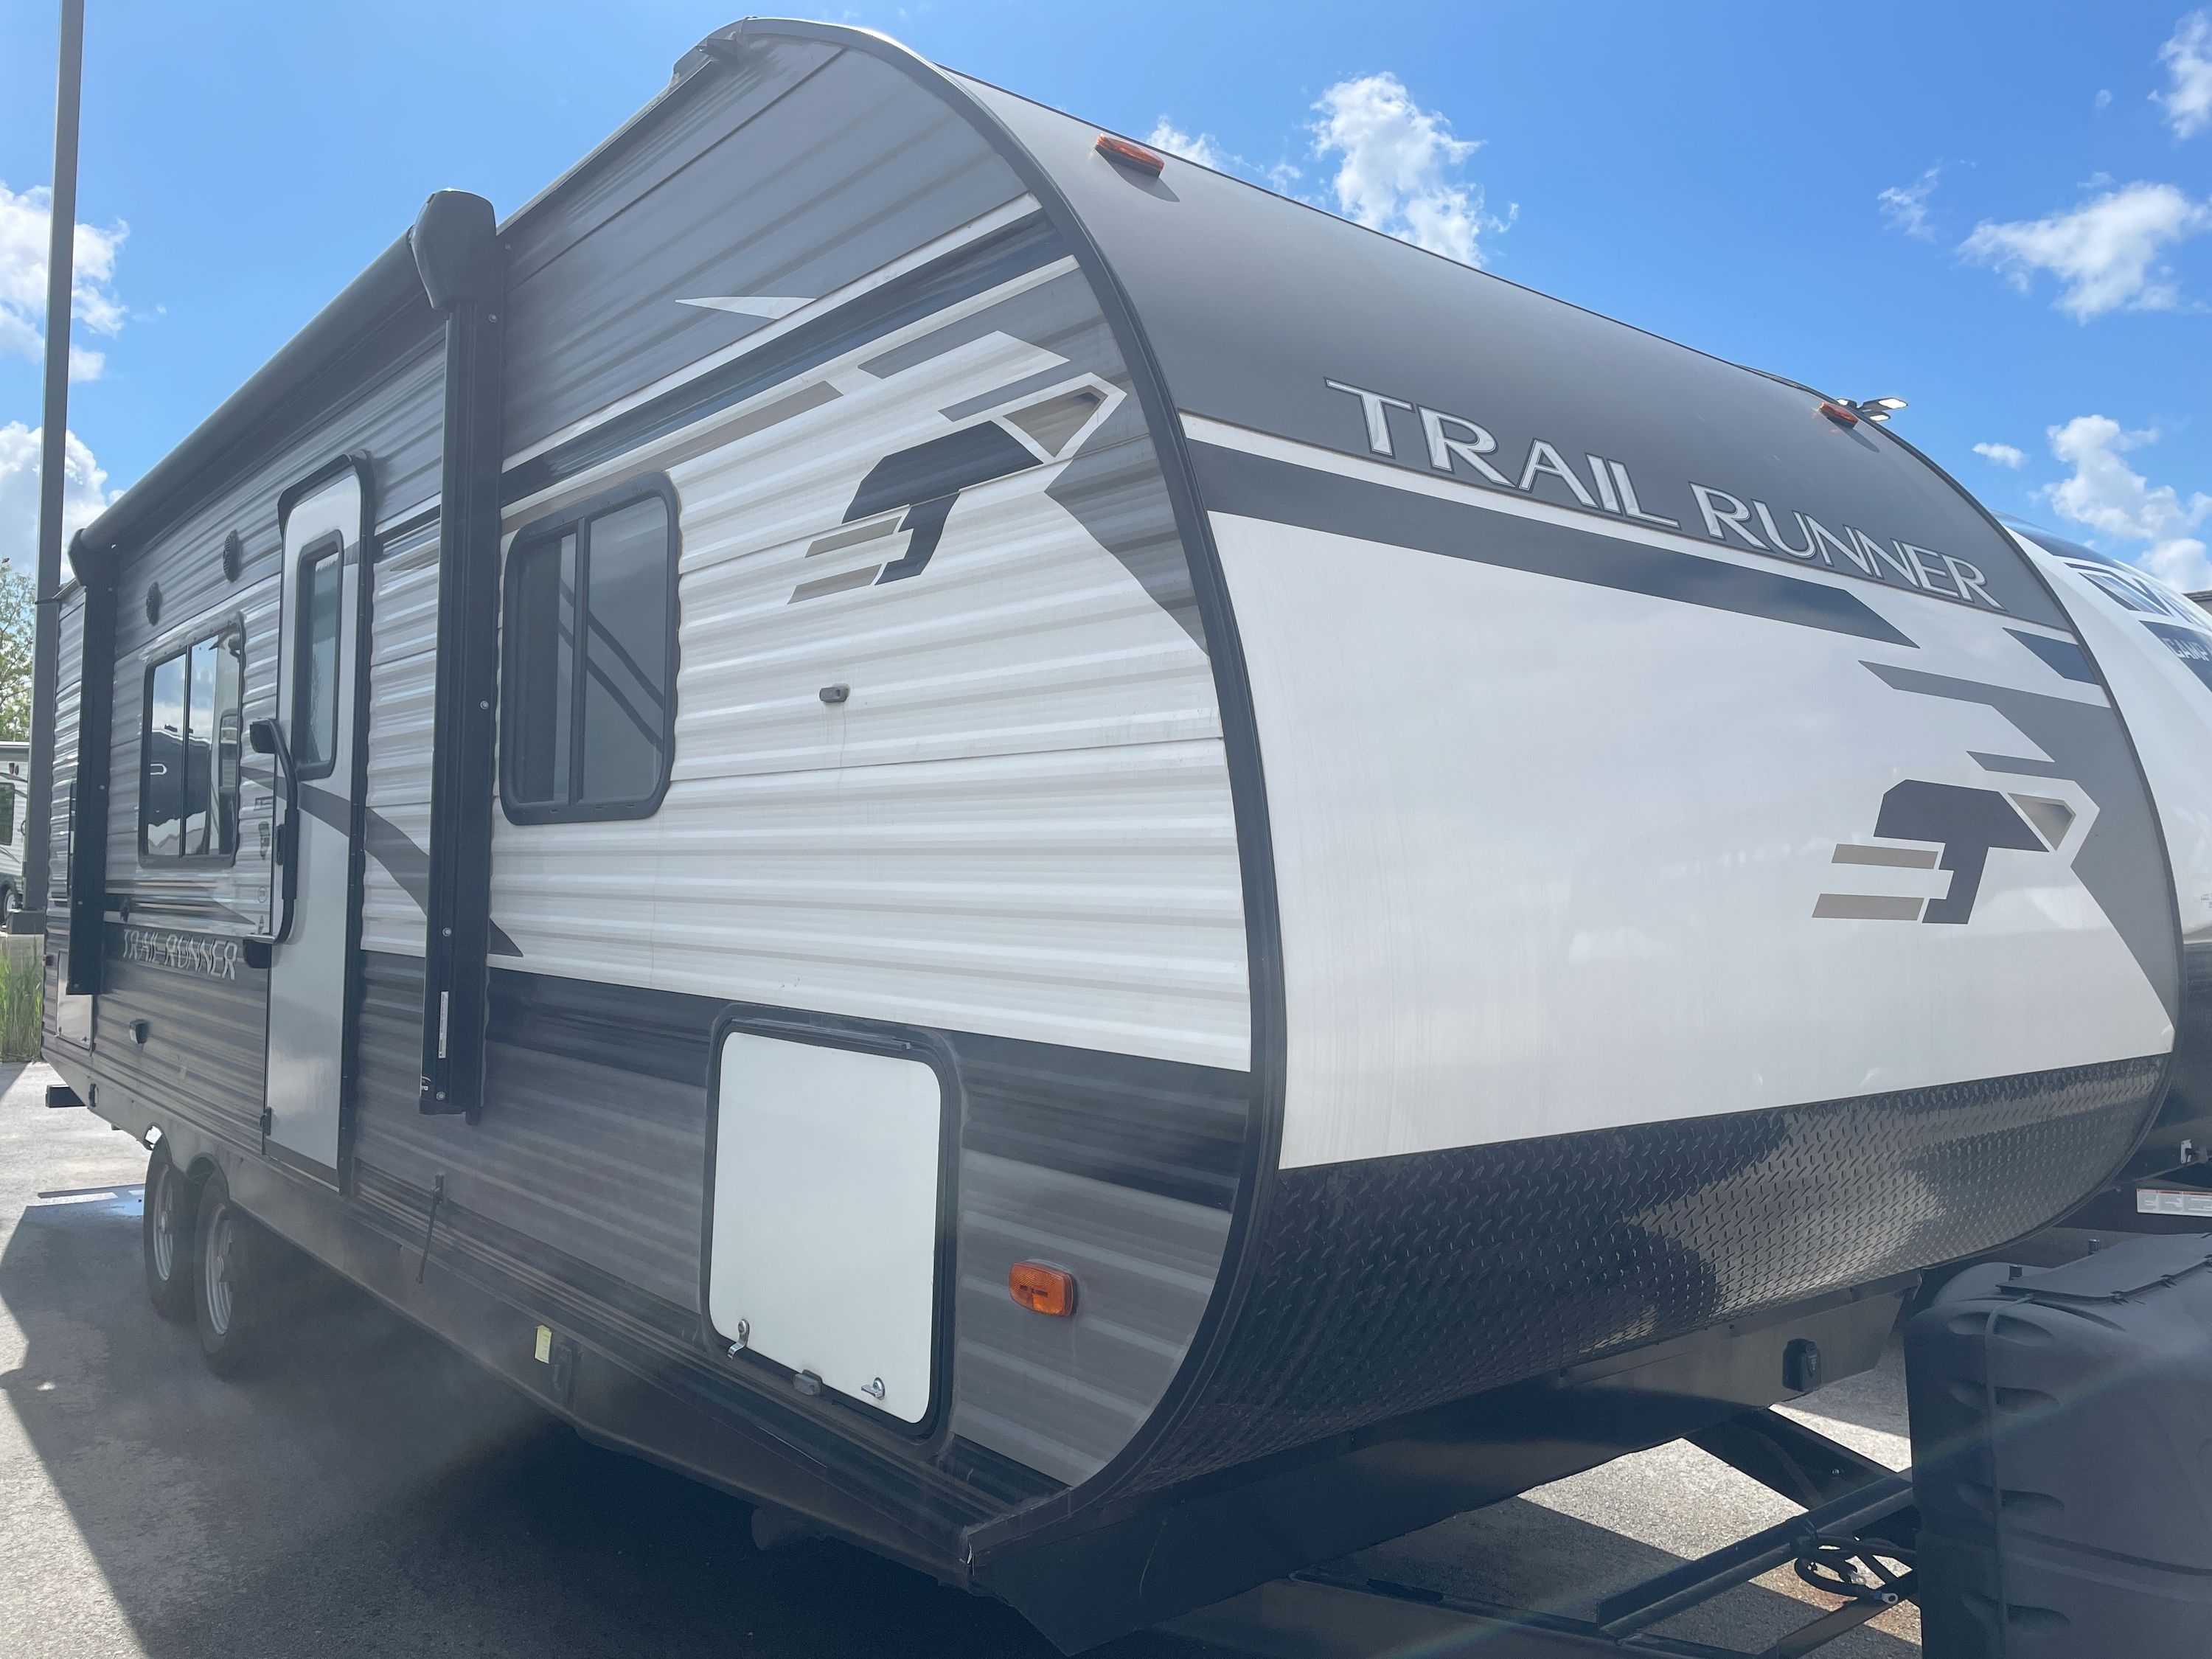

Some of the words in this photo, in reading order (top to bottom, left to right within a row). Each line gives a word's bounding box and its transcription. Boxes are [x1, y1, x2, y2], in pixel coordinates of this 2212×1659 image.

[1326, 378, 1681, 528] TRAIL
[1688, 481, 2006, 611] RUNNER
[123, 929, 160, 963] TRAIL
[164, 934, 238, 981] RUNNER
